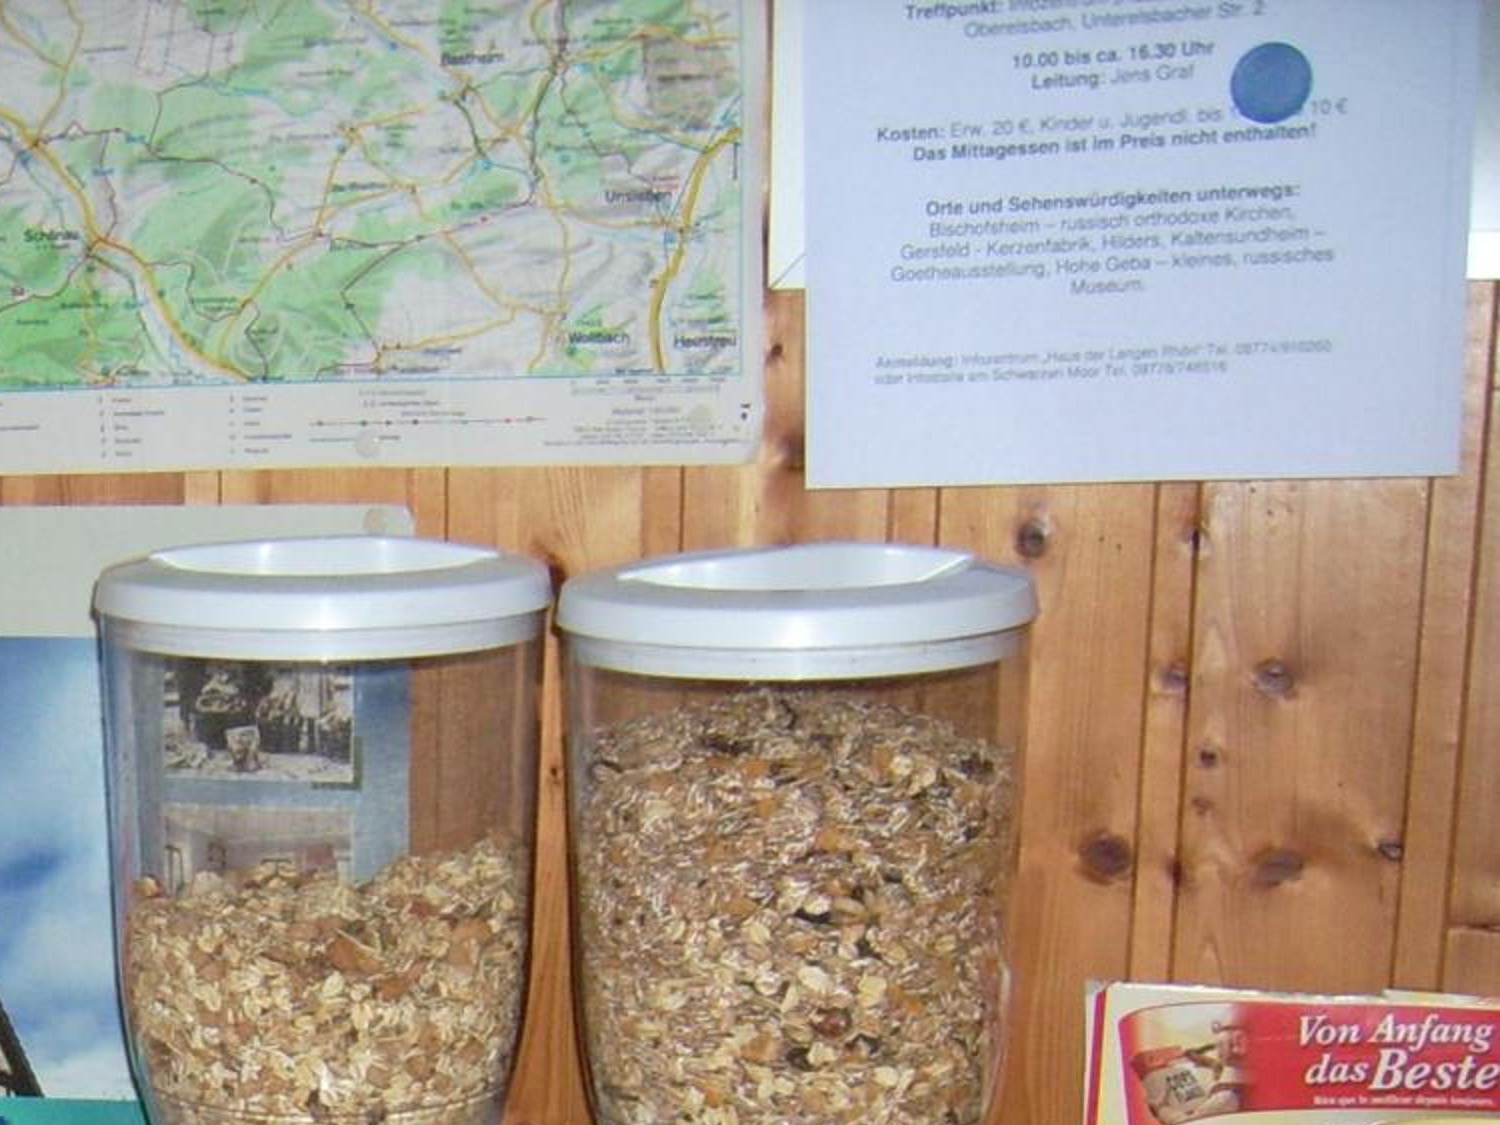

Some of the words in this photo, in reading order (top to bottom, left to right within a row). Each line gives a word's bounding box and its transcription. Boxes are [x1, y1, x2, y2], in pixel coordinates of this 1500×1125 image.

[1013, 51, 1059, 68] 10.00
[1063, 49, 1091, 66] bis
[1096, 48, 1122, 63] ca.
[1130, 42, 1176, 60] 16.30
[1181, 40, 1216, 57] Uhr
[1031, 69, 1106, 90] Leitung:
[1110, 67, 1150, 84] Jens
[1155, 63, 1195, 81] Graf
[876, 125, 945, 142] Kosten:
[992, 119, 1013, 136] 20
[1040, 114, 1093, 132] Kinder
[1197, 106, 1223, 122] bis
[913, 145, 947, 161] Das
[951, 140, 1059, 159] Mittagessen
[1065, 137, 1087, 152] ist
[1092, 135, 1114, 150] im
[1120, 132, 1165, 148] Preis
[1171, 129, 1218, 145] nicht
[1223, 122, 1317, 143] enthalten!
[926, 199, 963, 216] Orte
[968, 197, 1003, 214] und
[1008, 189, 1191, 213] Sehenswürdigkeiten
[1197, 184, 1300, 202] unterwegs:
[1061, 213, 1129, 231] russisch
[1135, 209, 1219, 227] orthodoxe
[1056, 257, 1100, 273] Hohe
[1299, 1014, 1361, 1046] Von
[1367, 1012, 1494, 1053] Anfang
[1304, 1053, 1369, 1085] das
[1367, 1047, 1500, 1091] Beste
